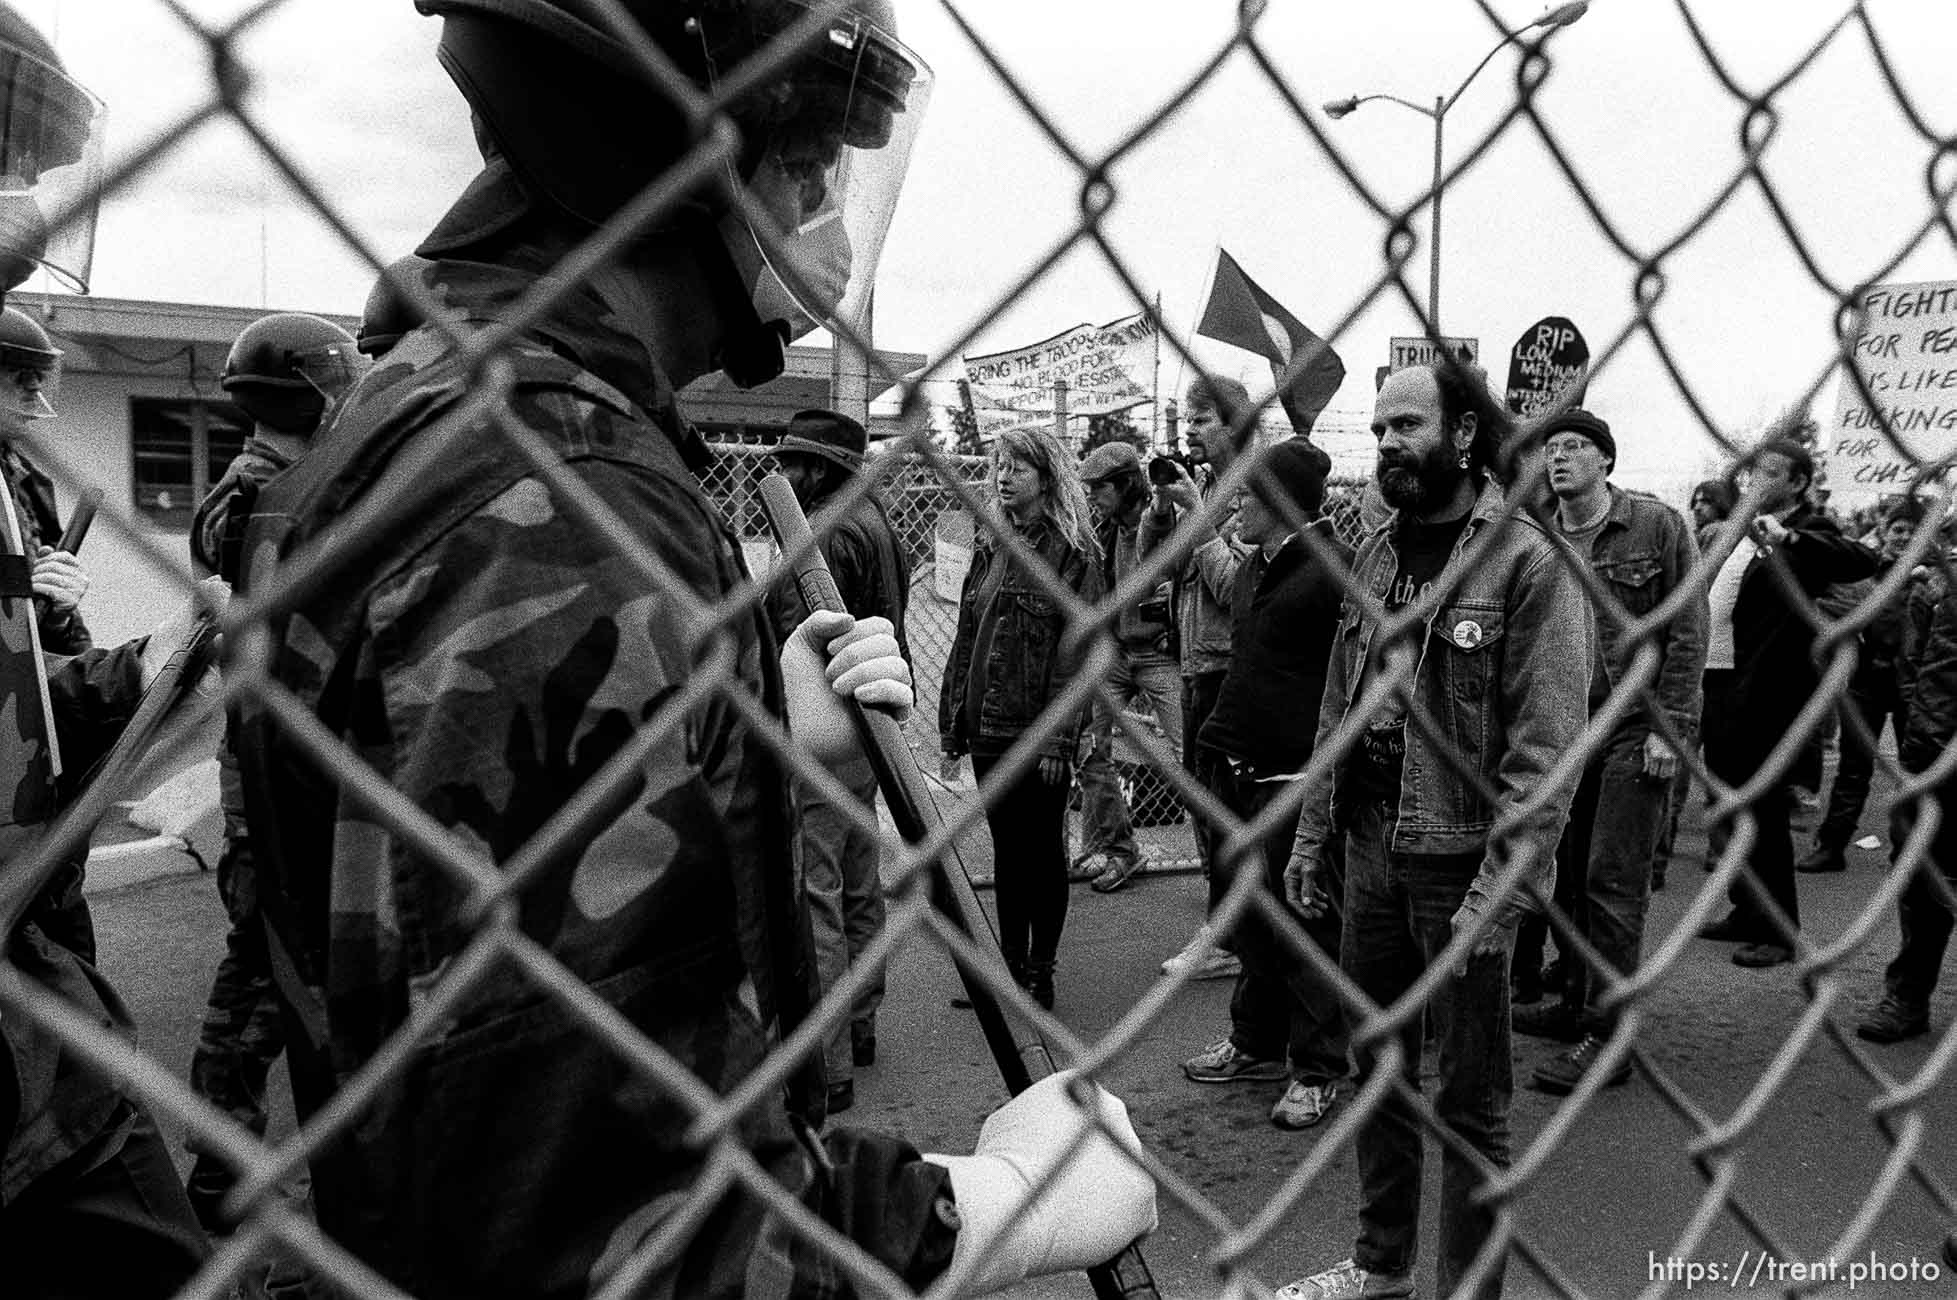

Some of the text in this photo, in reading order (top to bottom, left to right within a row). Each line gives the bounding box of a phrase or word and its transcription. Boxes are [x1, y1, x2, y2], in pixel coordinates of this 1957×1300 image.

[1536, 325, 1575, 350] RIP
[1853, 333, 1902, 358] FOR
[966, 360, 1010, 383] BRING
[1015, 352, 1041, 373] THE
[1047, 333, 1095, 361] TROOPS
[1520, 360, 1580, 378] MEDIUM
[1868, 369, 1957, 391] IS LIKE
[1834, 438, 1881, 457] FOR
